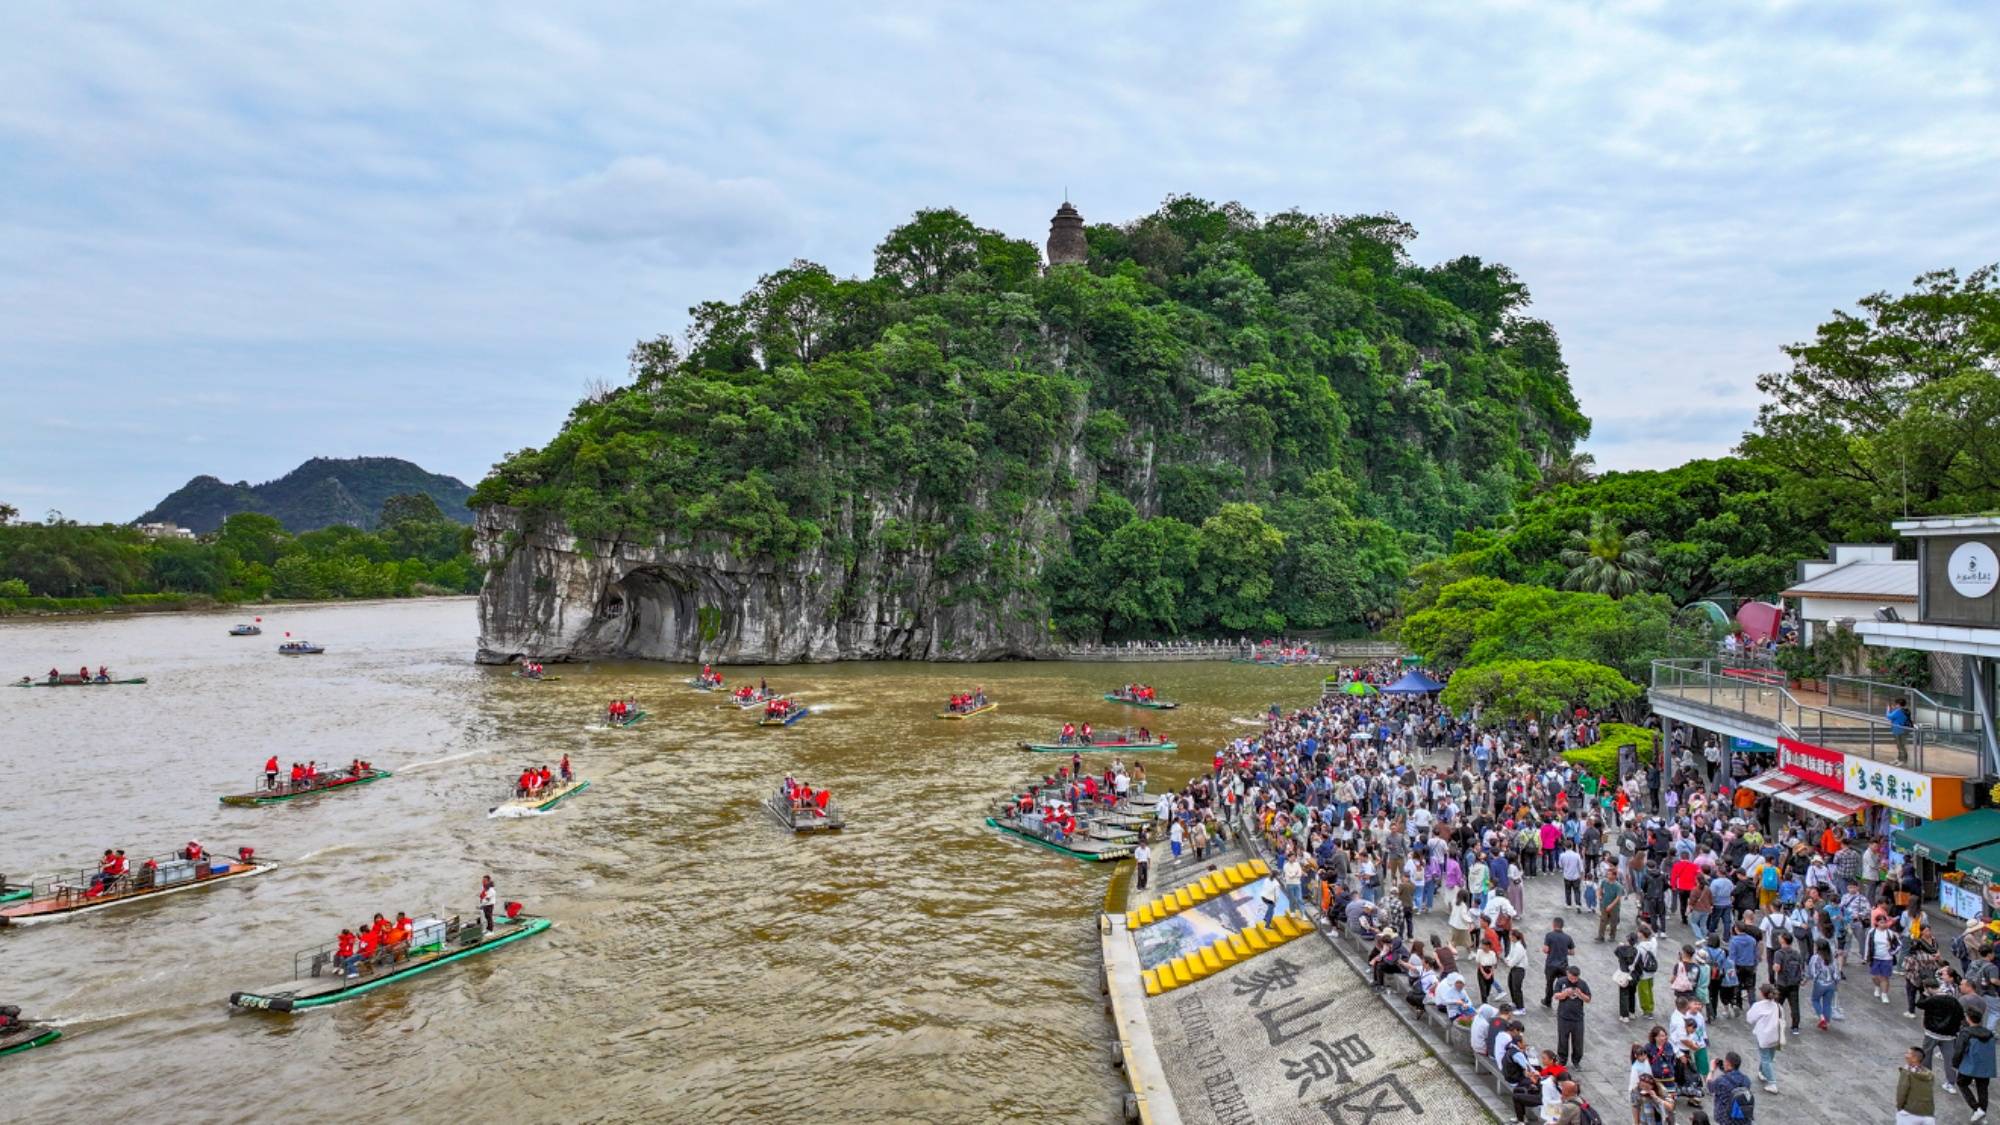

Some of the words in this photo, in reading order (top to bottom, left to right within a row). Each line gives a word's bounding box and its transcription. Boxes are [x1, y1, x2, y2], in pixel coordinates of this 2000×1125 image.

[1857, 766, 1914, 802] 多喝果汁
[1194, 1045, 1226, 1070] TO
[1231, 958, 1425, 1125] 象山景区
